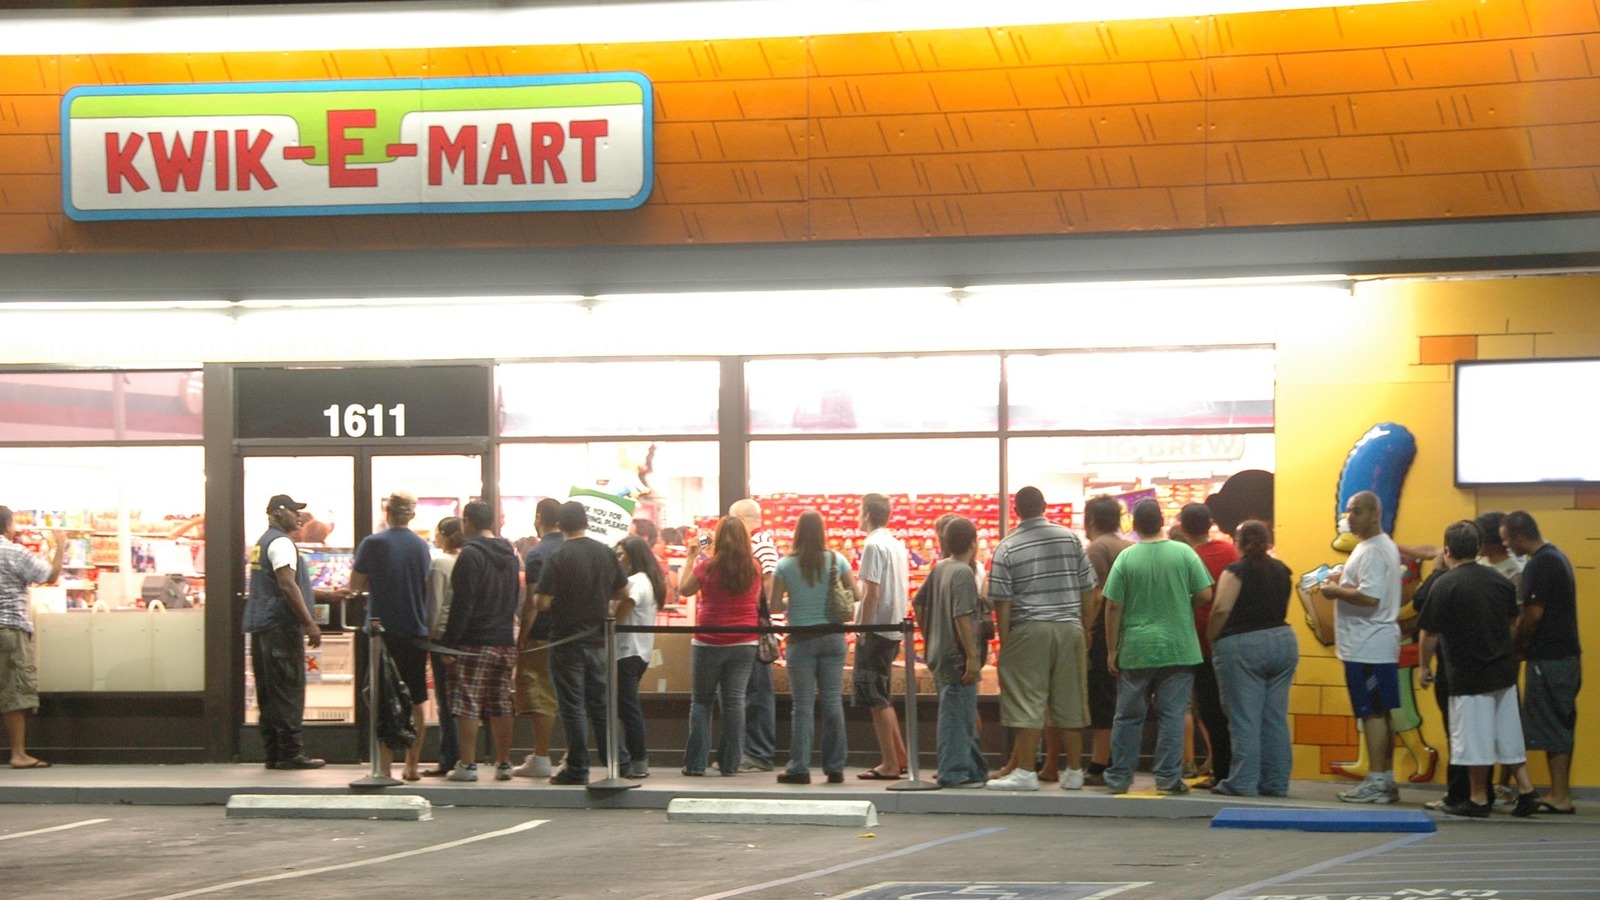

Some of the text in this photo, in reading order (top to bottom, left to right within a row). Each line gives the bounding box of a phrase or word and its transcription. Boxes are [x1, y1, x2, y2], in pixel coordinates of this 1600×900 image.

[105, 109, 608, 194] KWIK-E-MART
[323, 403, 405, 437] 1611
[1084, 436, 1237, 457] BIG BREW
[593, 508, 607, 517] YOU
[609, 511, 622, 520] FOR
[604, 519, 629, 531] PLEASE
[1393, 888, 1499, 897] NO
